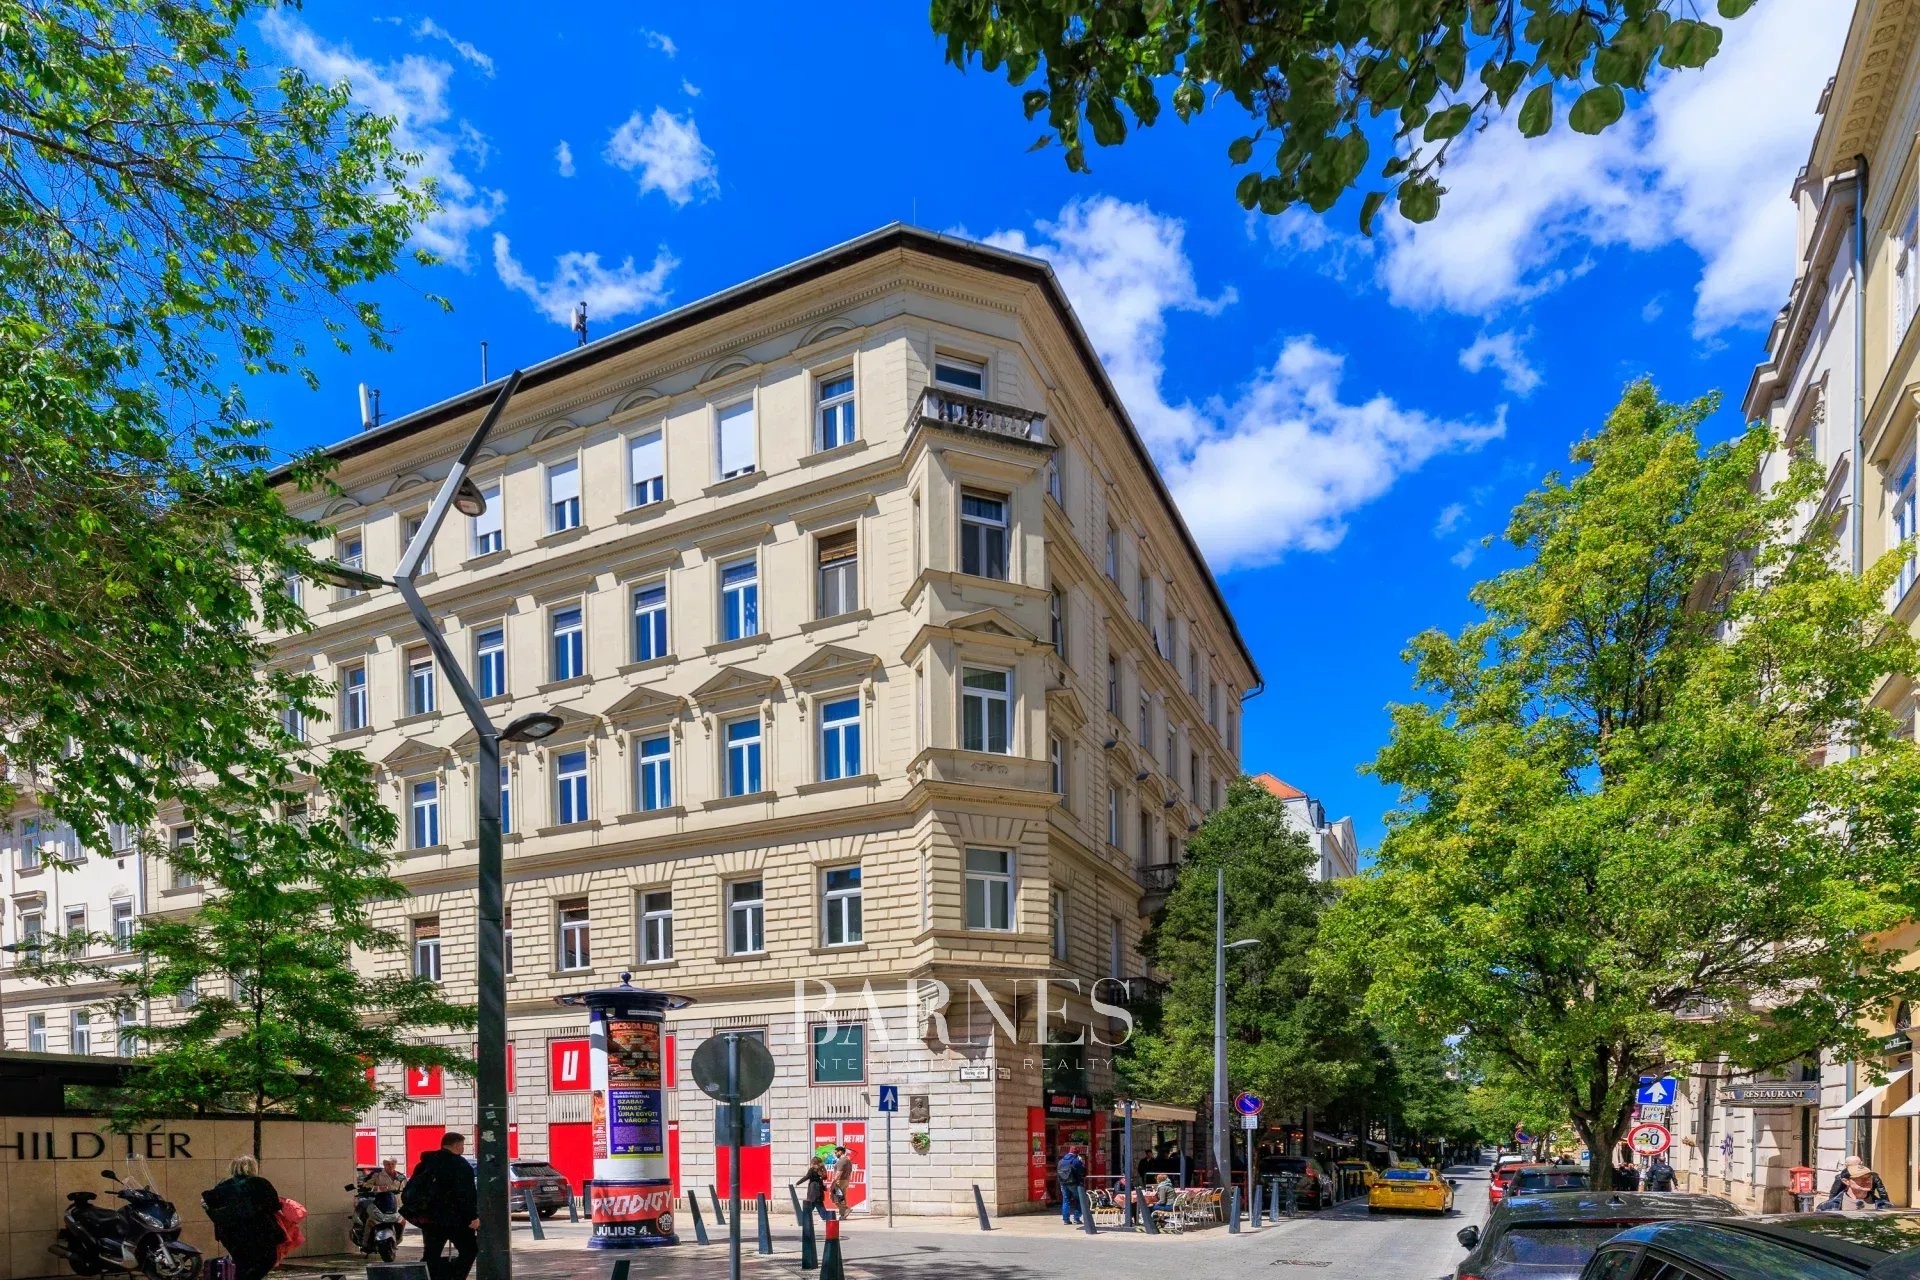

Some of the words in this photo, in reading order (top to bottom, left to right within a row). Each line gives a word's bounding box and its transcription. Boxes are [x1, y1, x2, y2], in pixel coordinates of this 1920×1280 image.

[1743, 1090, 1805, 1099] RESTAURANT
[117, 1124, 192, 1159] TÉR
[592, 1190, 672, 1216] PRODIGY
[596, 1224, 636, 1236] JÚLIUS
[639, 1226, 652, 1235] 4.
